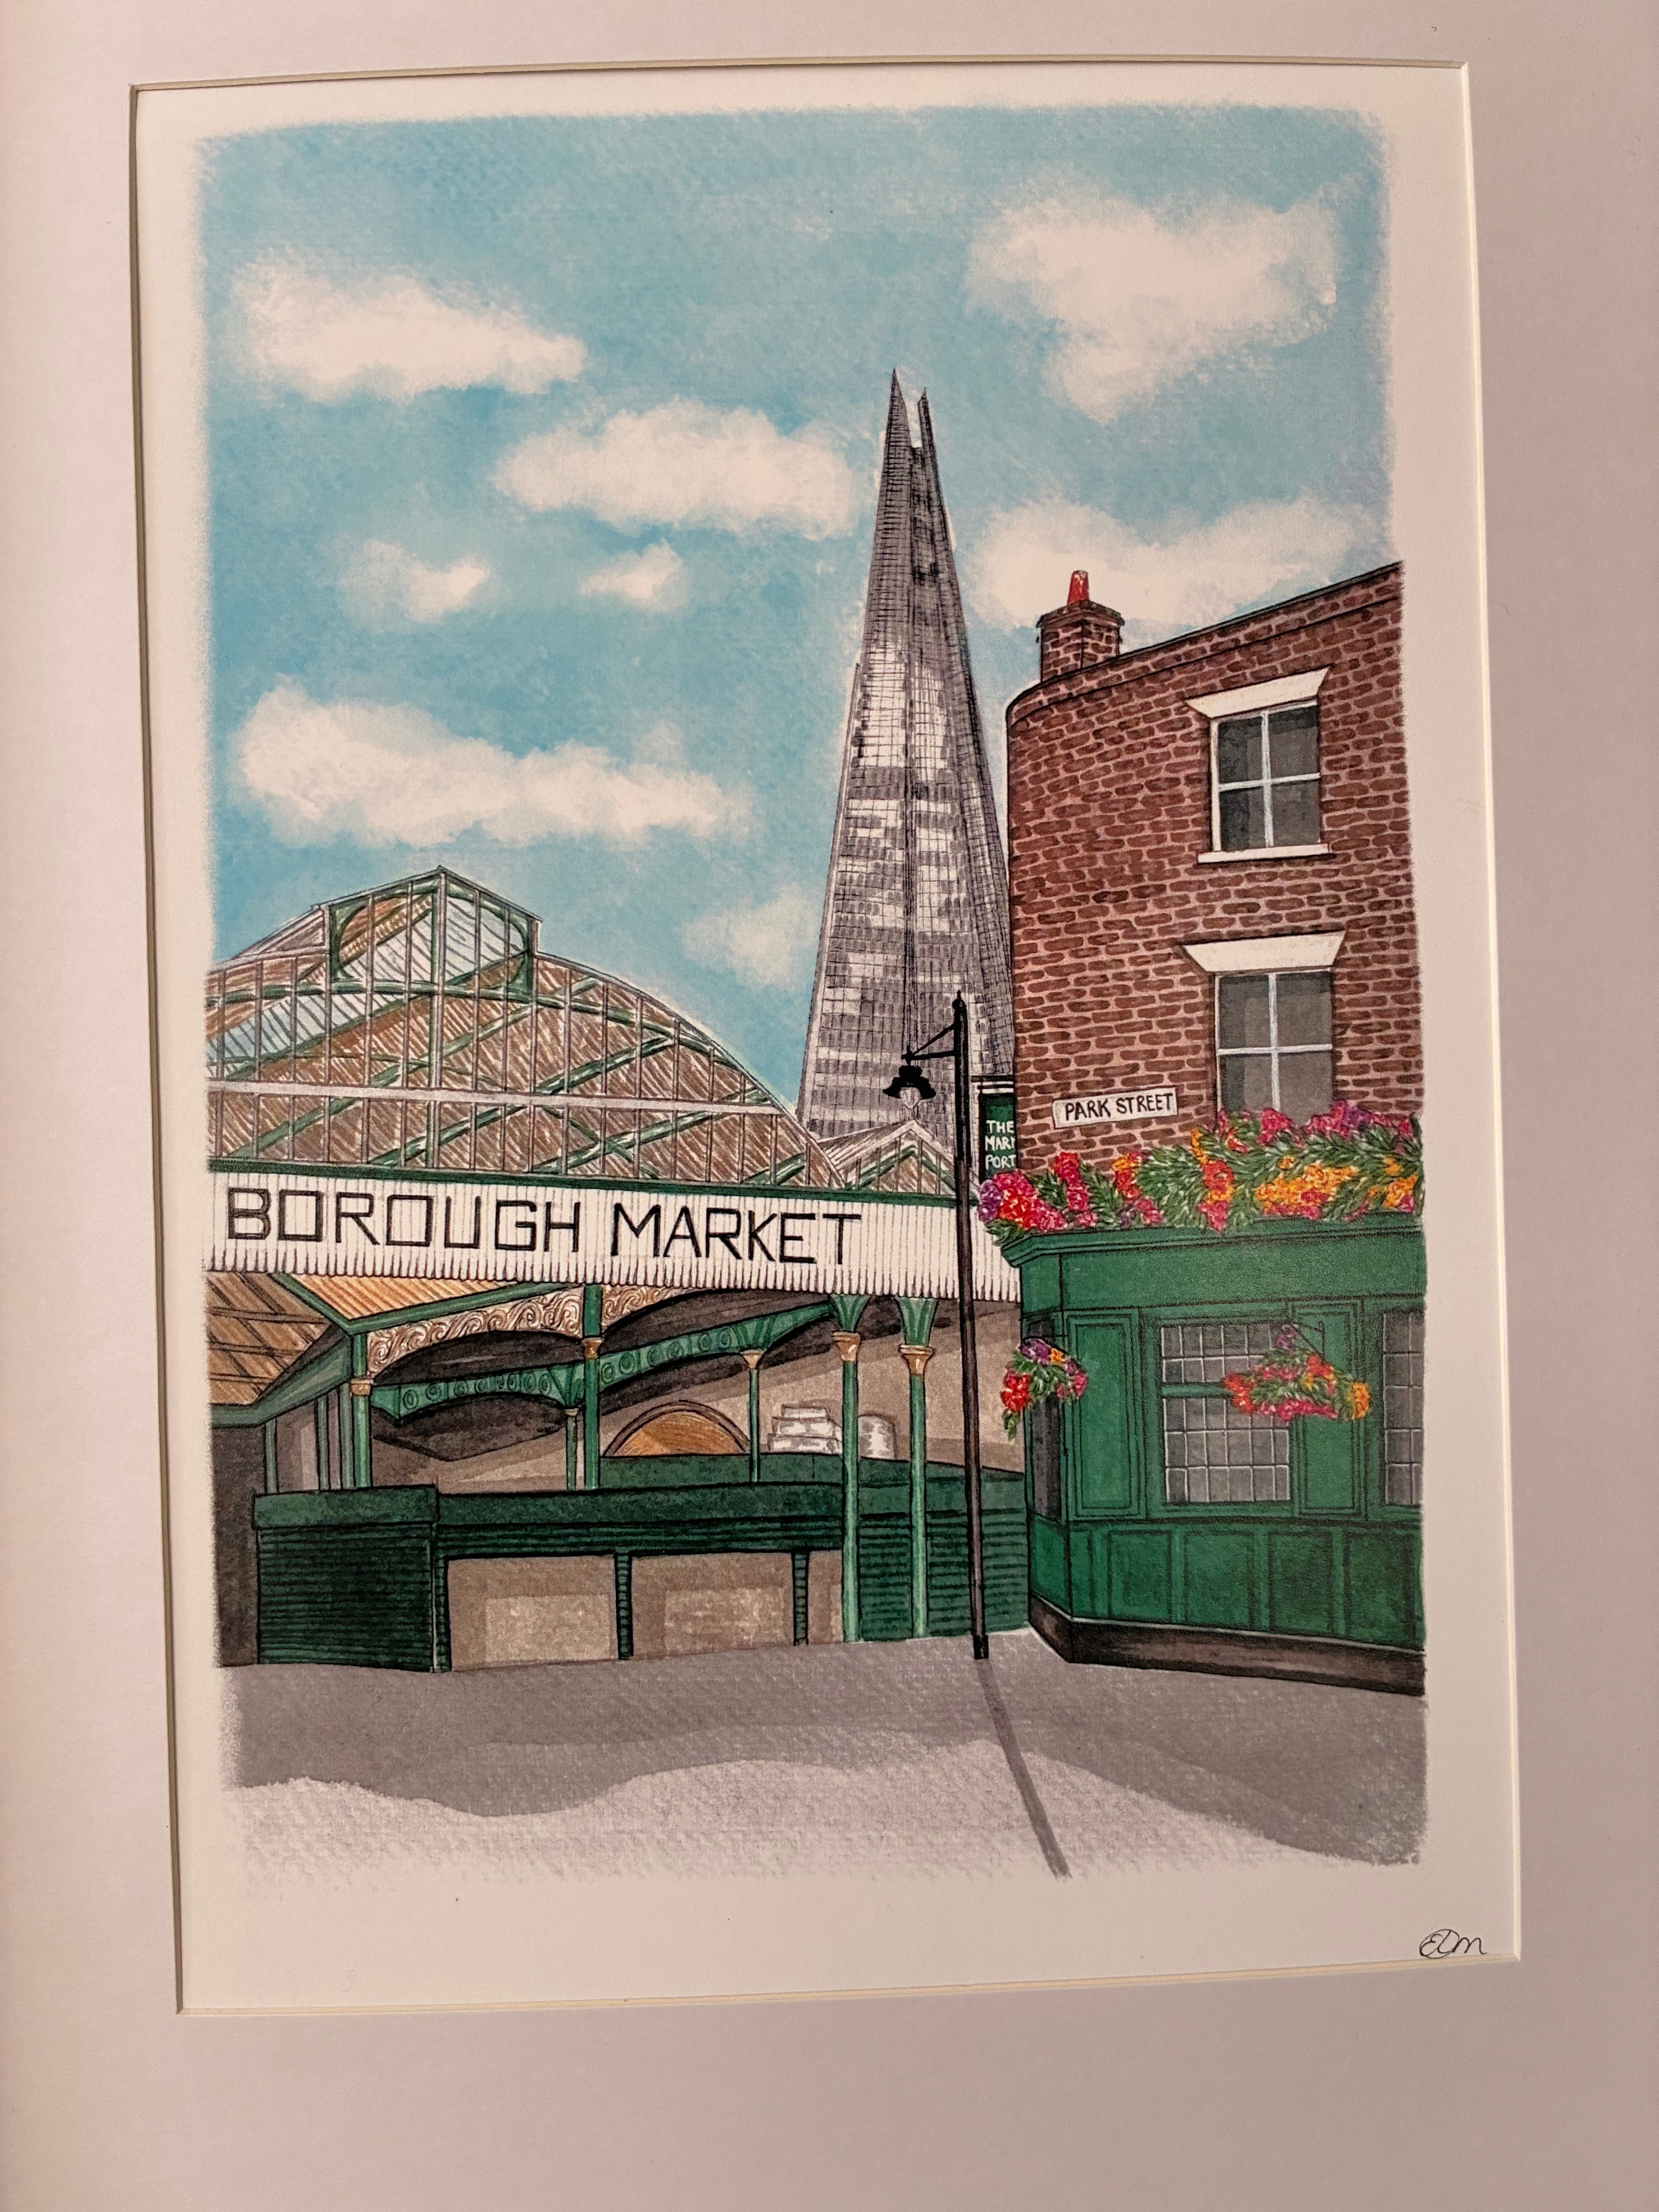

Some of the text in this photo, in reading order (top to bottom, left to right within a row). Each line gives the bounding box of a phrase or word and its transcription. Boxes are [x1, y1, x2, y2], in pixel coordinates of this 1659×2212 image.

[1065, 1093, 1173, 1121] PARK STREET
[986, 1120, 1014, 1134] THE
[985, 1154, 1017, 1170] PORT
[227, 1186, 861, 1265] BOROUGH MARKET
